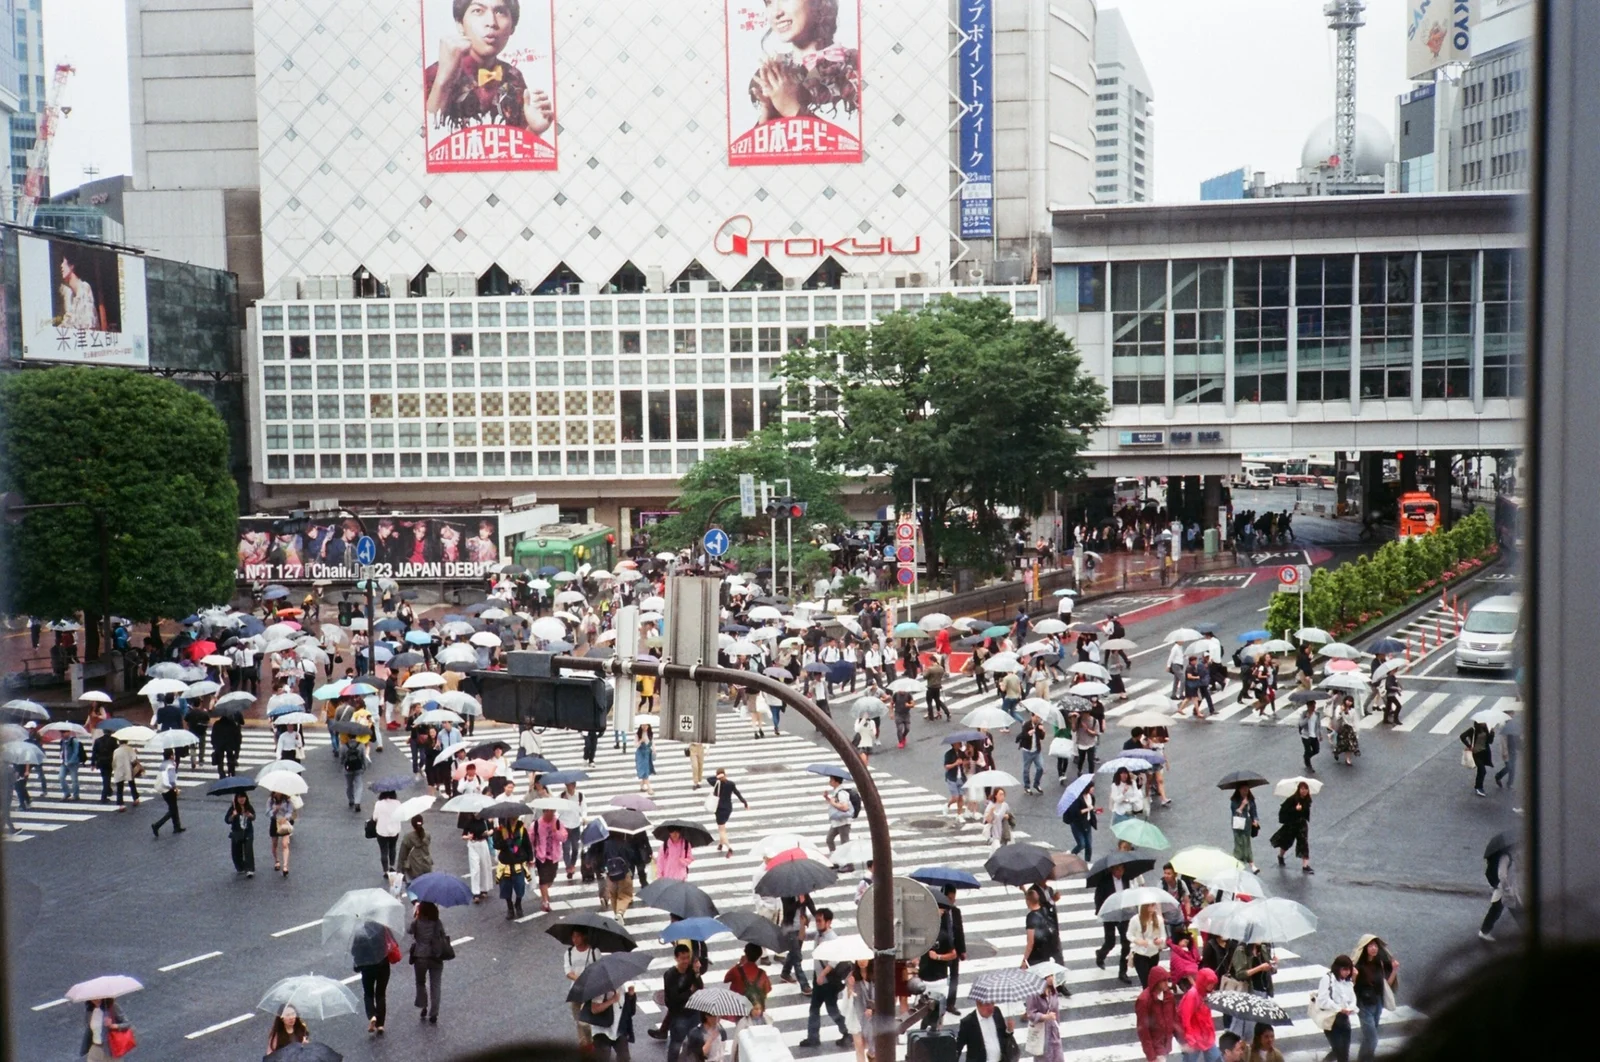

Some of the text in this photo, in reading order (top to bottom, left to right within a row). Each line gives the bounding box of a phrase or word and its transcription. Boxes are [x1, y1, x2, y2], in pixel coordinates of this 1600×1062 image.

[1454, 0, 1469, 50] KYO
[968, 0, 985, 167] プポイントウィーク
[451, 127, 531, 159] 日本ダービー
[754, 119, 836, 152] 日本ダービー
[750, 236, 920, 257] TOKYU
[56, 325, 119, 352] 米津玄師
[245, 564, 273, 579] NCT
[276, 564, 302, 579] 127
[395, 562, 441, 577] JAPAN
